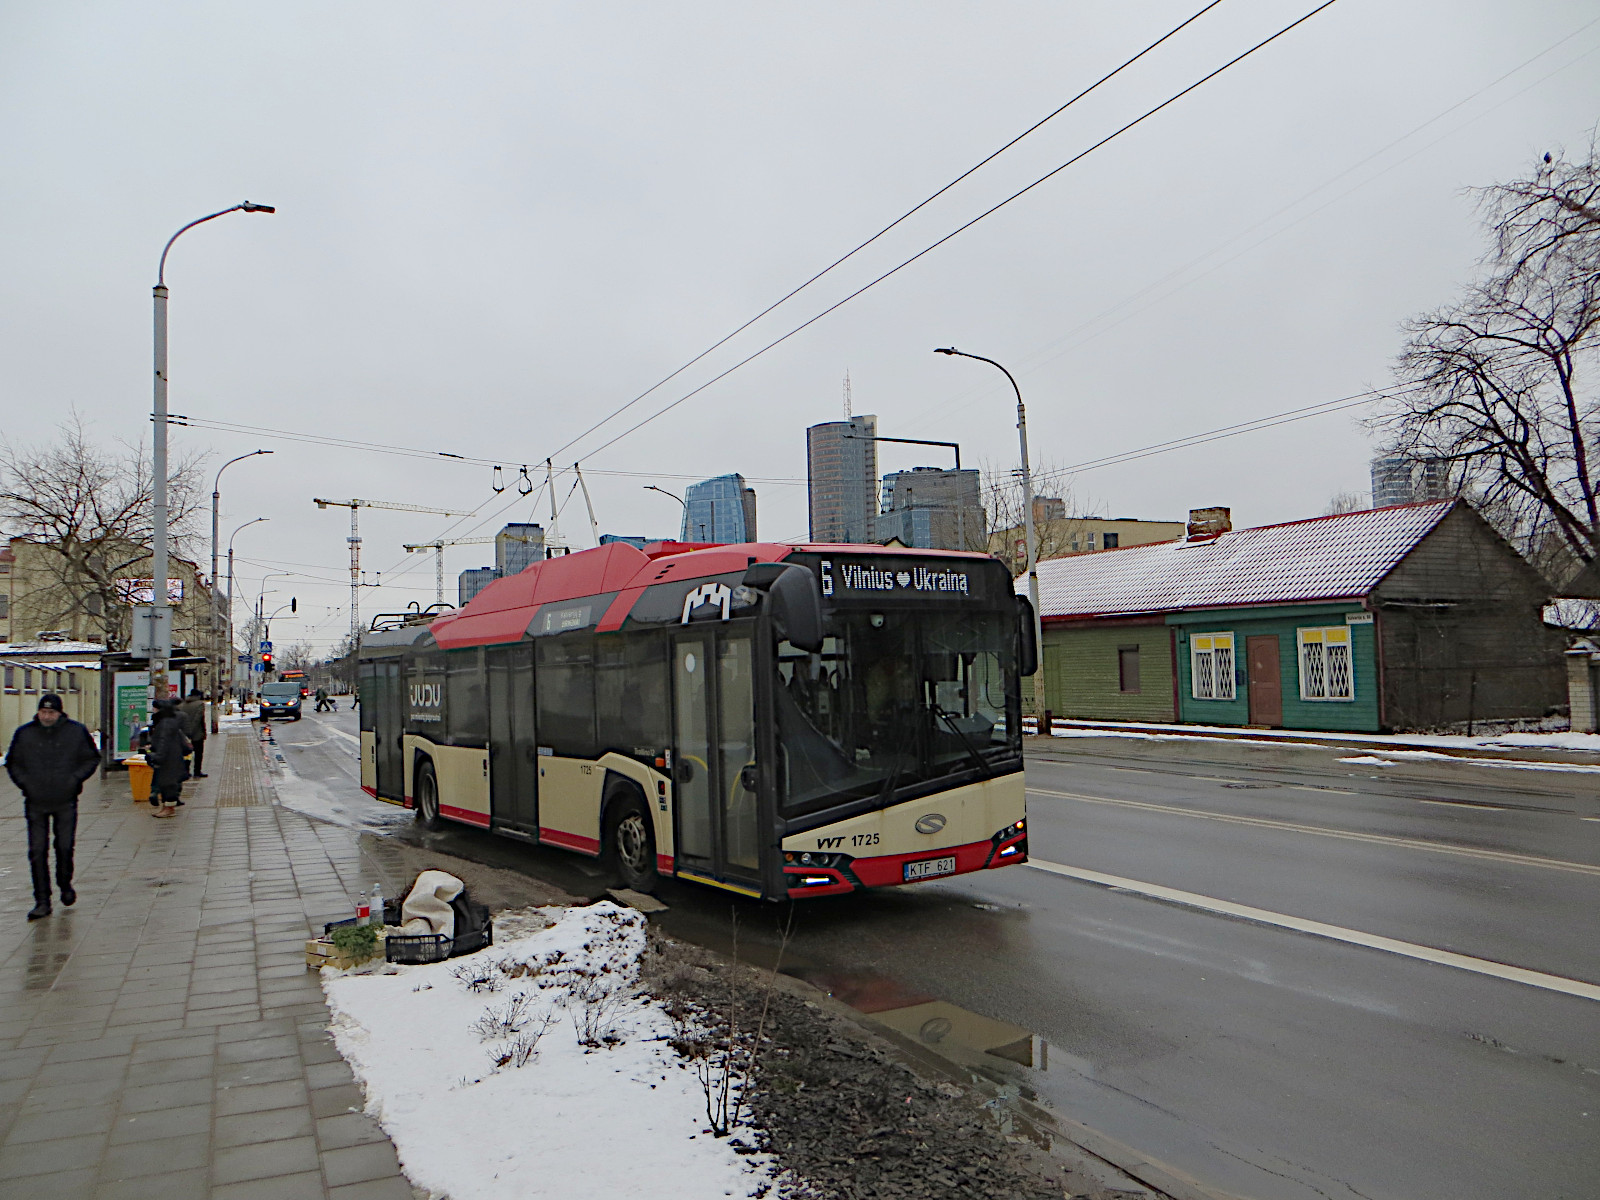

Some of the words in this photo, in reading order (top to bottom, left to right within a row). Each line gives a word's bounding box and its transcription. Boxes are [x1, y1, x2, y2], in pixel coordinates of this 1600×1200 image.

[821, 561, 833, 595] 6
[841, 565, 894, 590] Vilnius
[913, 567, 968, 595] Ukrainą
[410, 684, 440, 706] JUDU
[580, 765, 592, 775] 1725
[817, 836, 846, 849] VVT
[851, 833, 880, 847] 1725
[910, 862, 931, 876] KTF
[937, 858, 953, 872] 621
